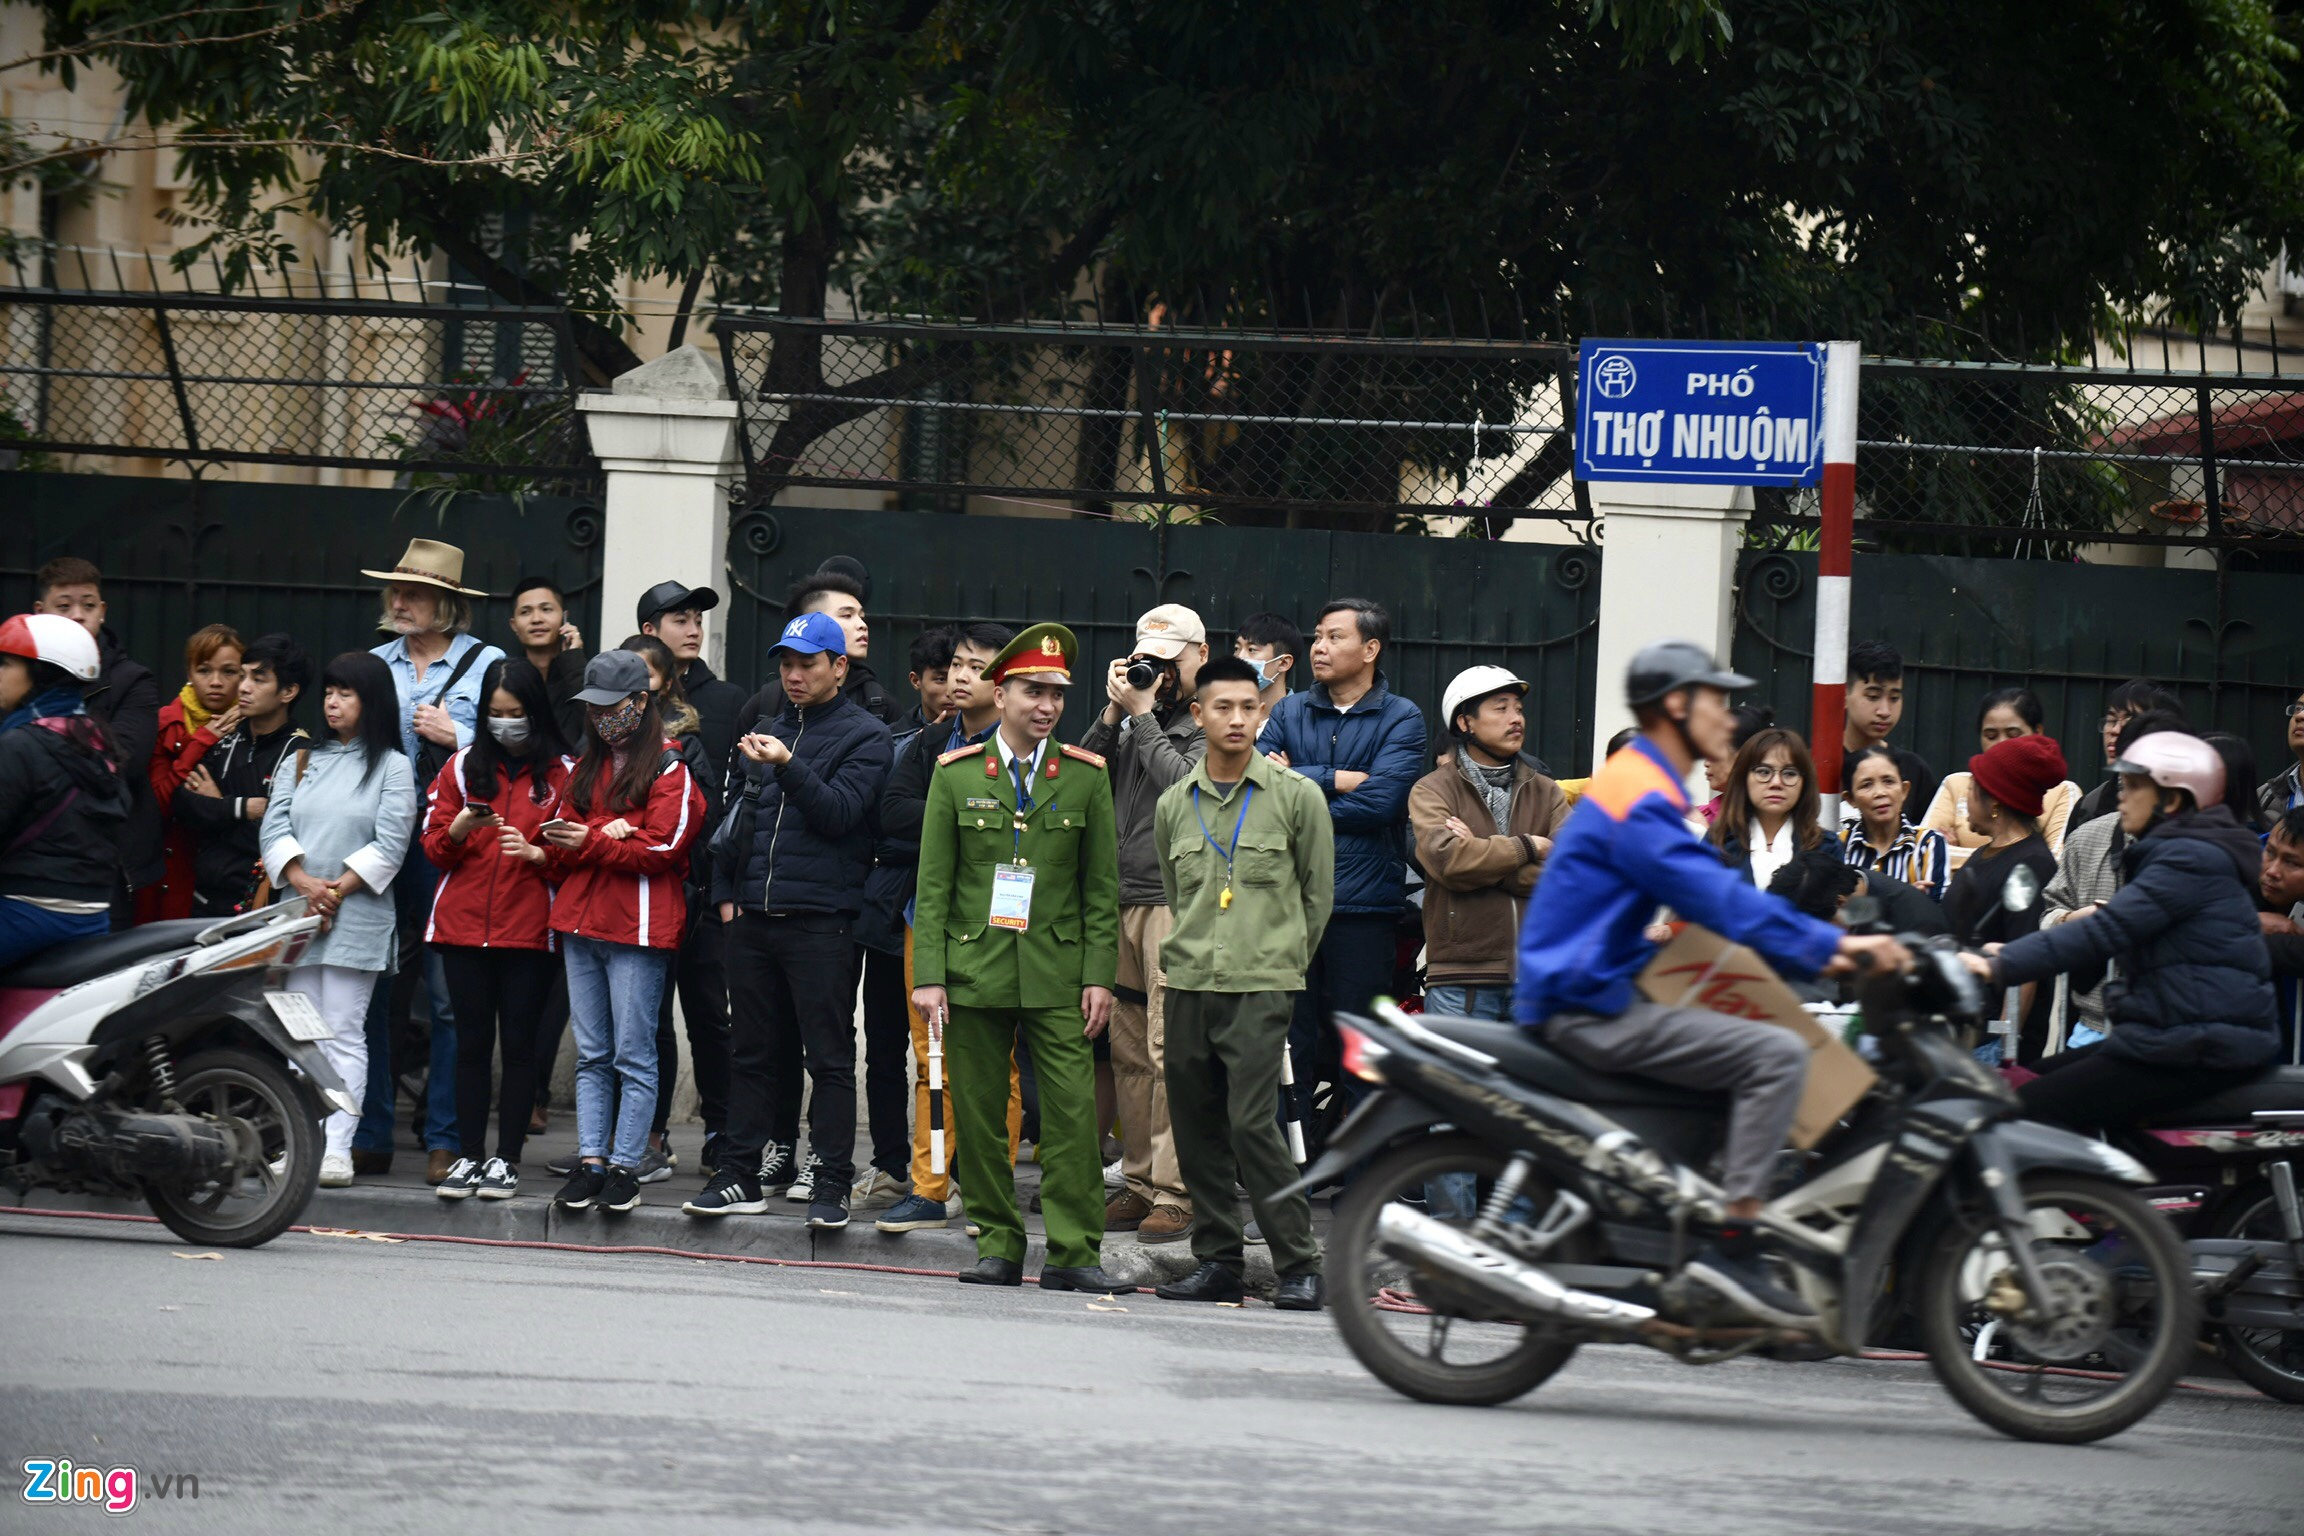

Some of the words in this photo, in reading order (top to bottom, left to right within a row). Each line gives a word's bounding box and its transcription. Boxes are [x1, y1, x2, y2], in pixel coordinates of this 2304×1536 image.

[1686, 364, 1758, 397] PHỐ
[1593, 410, 1664, 467] THỢ
[1672, 406, 1808, 471] NHUỘM
[992, 917, 1026, 927] SECURITY
